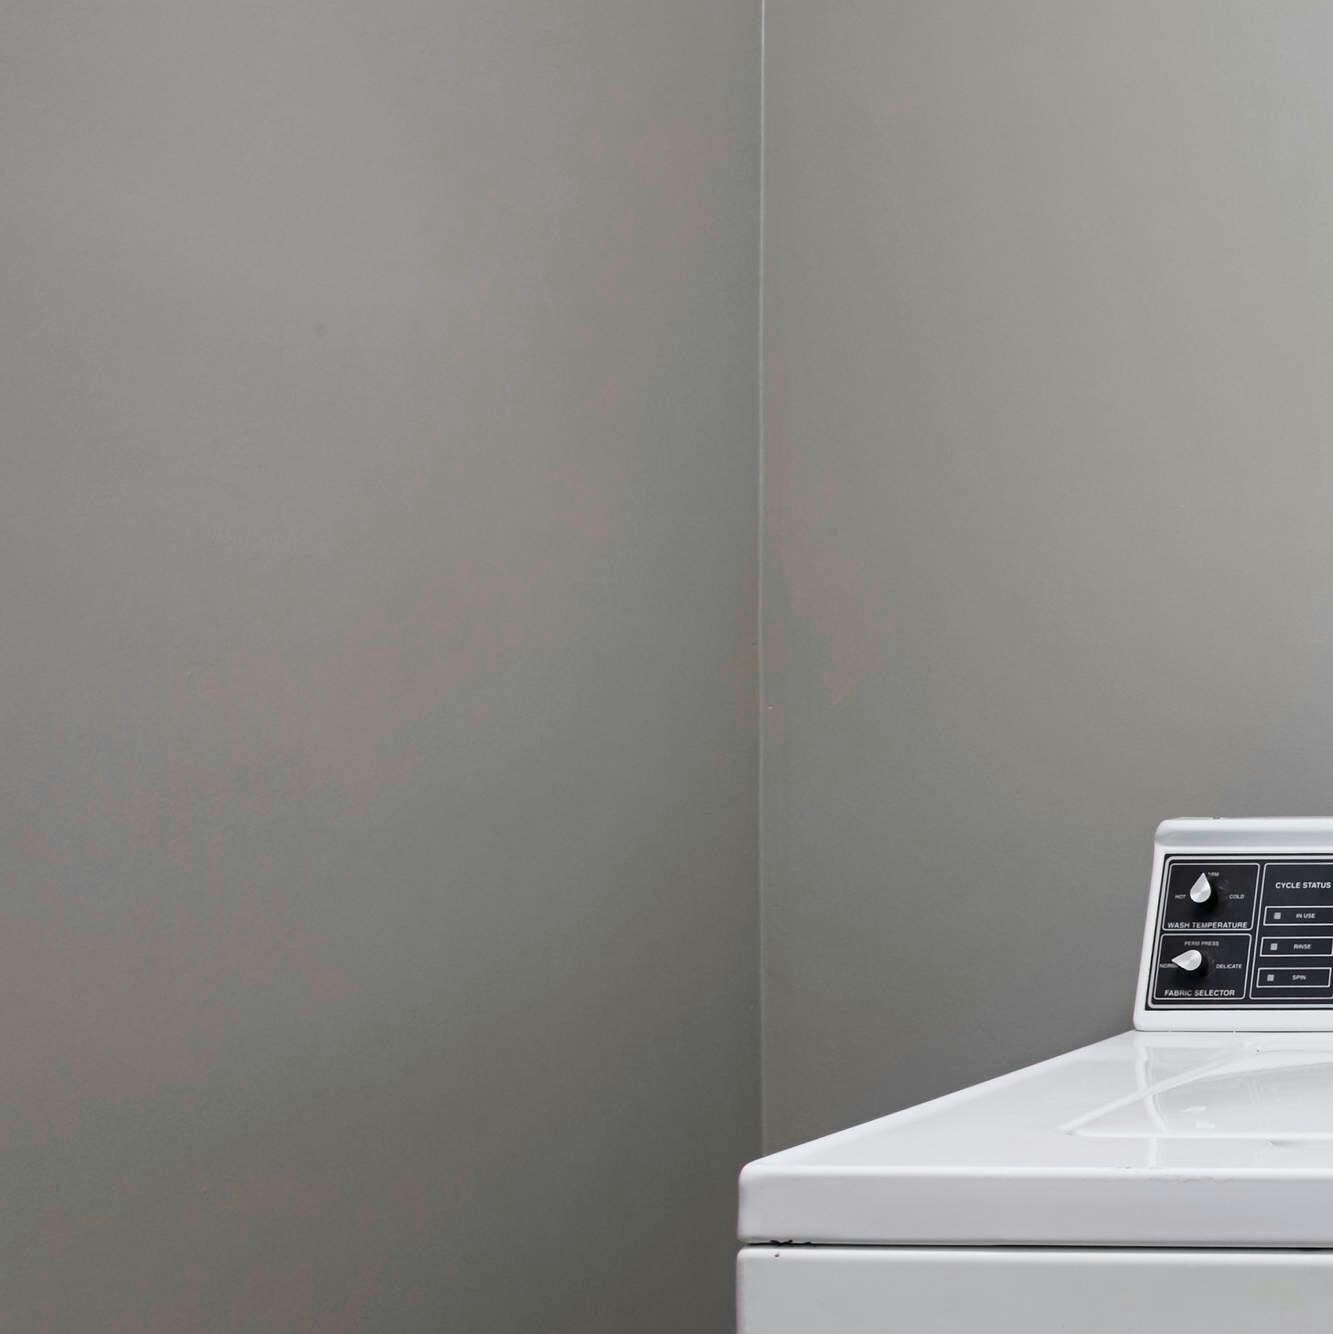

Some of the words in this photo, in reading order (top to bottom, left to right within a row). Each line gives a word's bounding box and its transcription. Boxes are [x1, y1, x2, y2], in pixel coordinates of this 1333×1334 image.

[1275, 881, 1301, 889] CYCLE
[1302, 881, 1332, 889] STATUS
[1167, 921, 1191, 929] WASH
[1192, 921, 1248, 929] TEMPERATURE
[1164, 989, 1192, 997] FABRIC
[1194, 989, 1236, 997] SELECTOR
